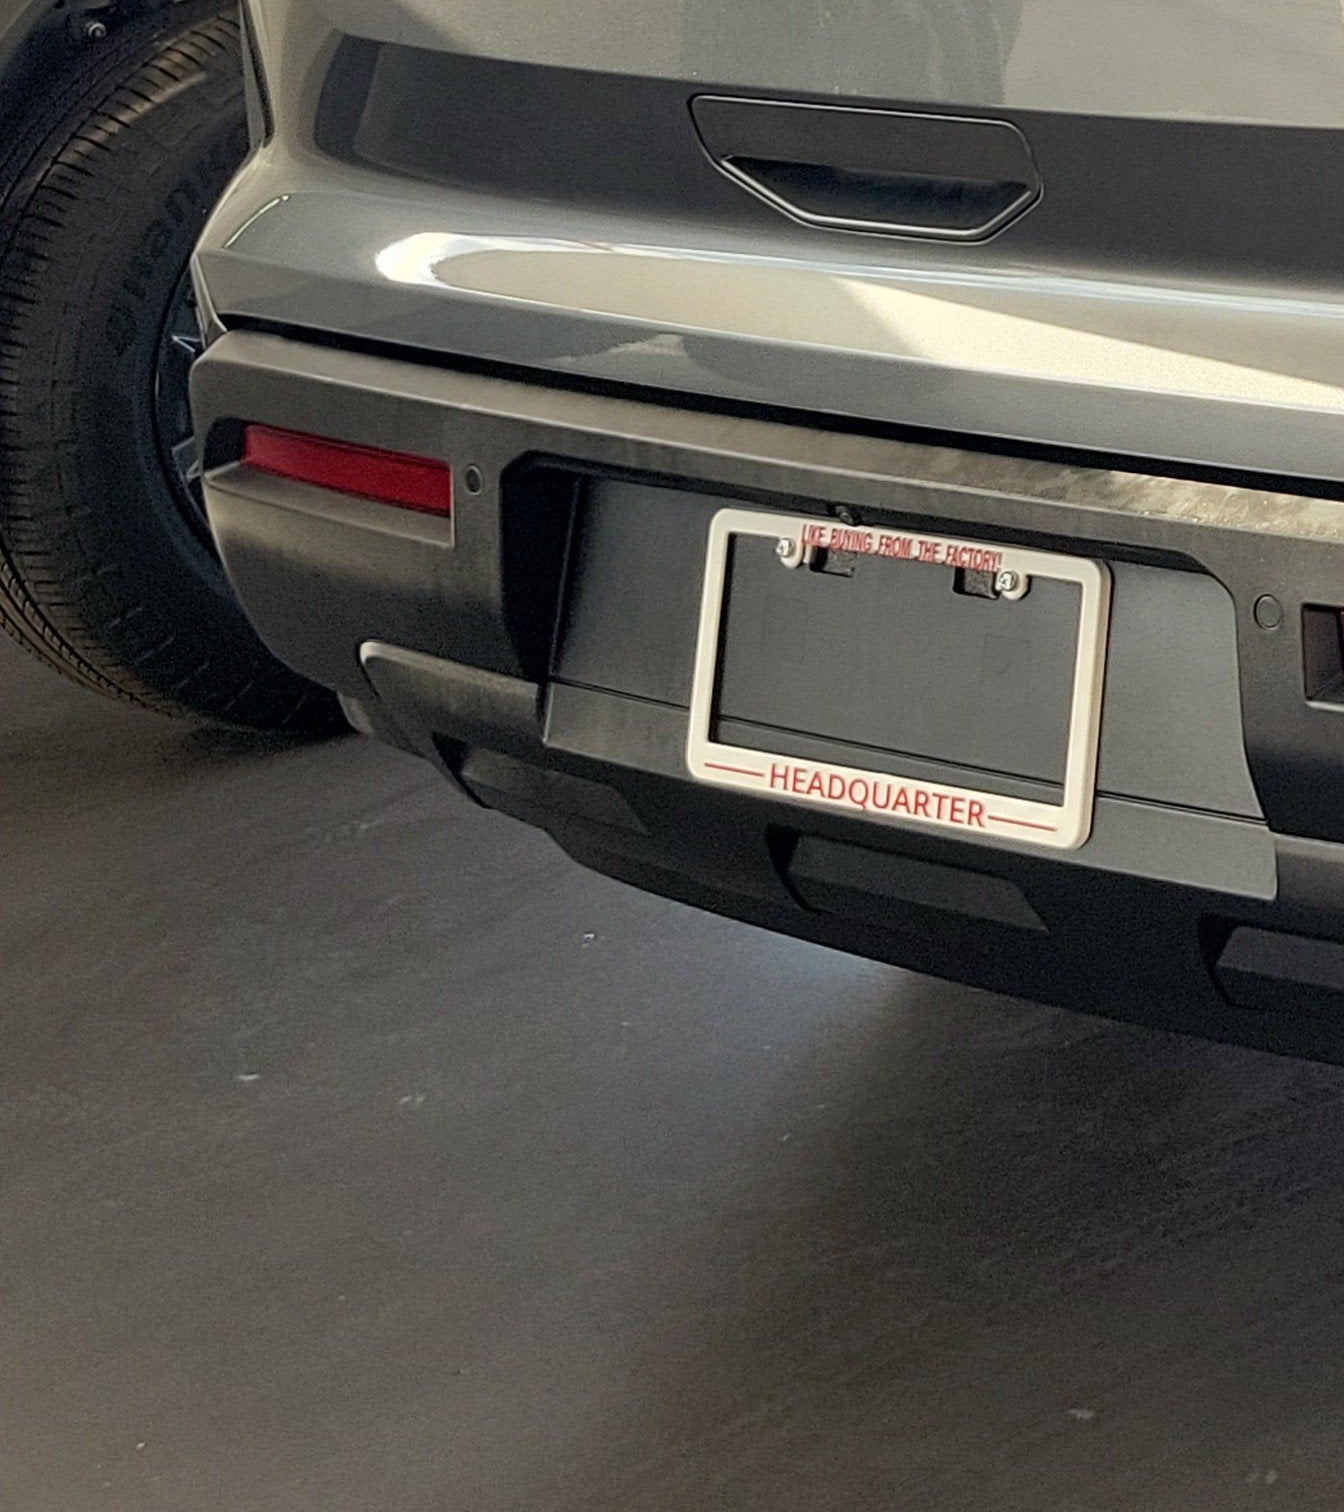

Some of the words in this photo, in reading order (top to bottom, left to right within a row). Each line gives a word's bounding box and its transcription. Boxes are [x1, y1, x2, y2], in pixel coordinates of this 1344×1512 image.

[802, 523, 826, 547] LIKE
[829, 527, 873, 554] BUYING
[877, 533, 913, 560] FROM
[917, 540, 942, 565] THE
[768, 762, 987, 828] HEADQUARTER
